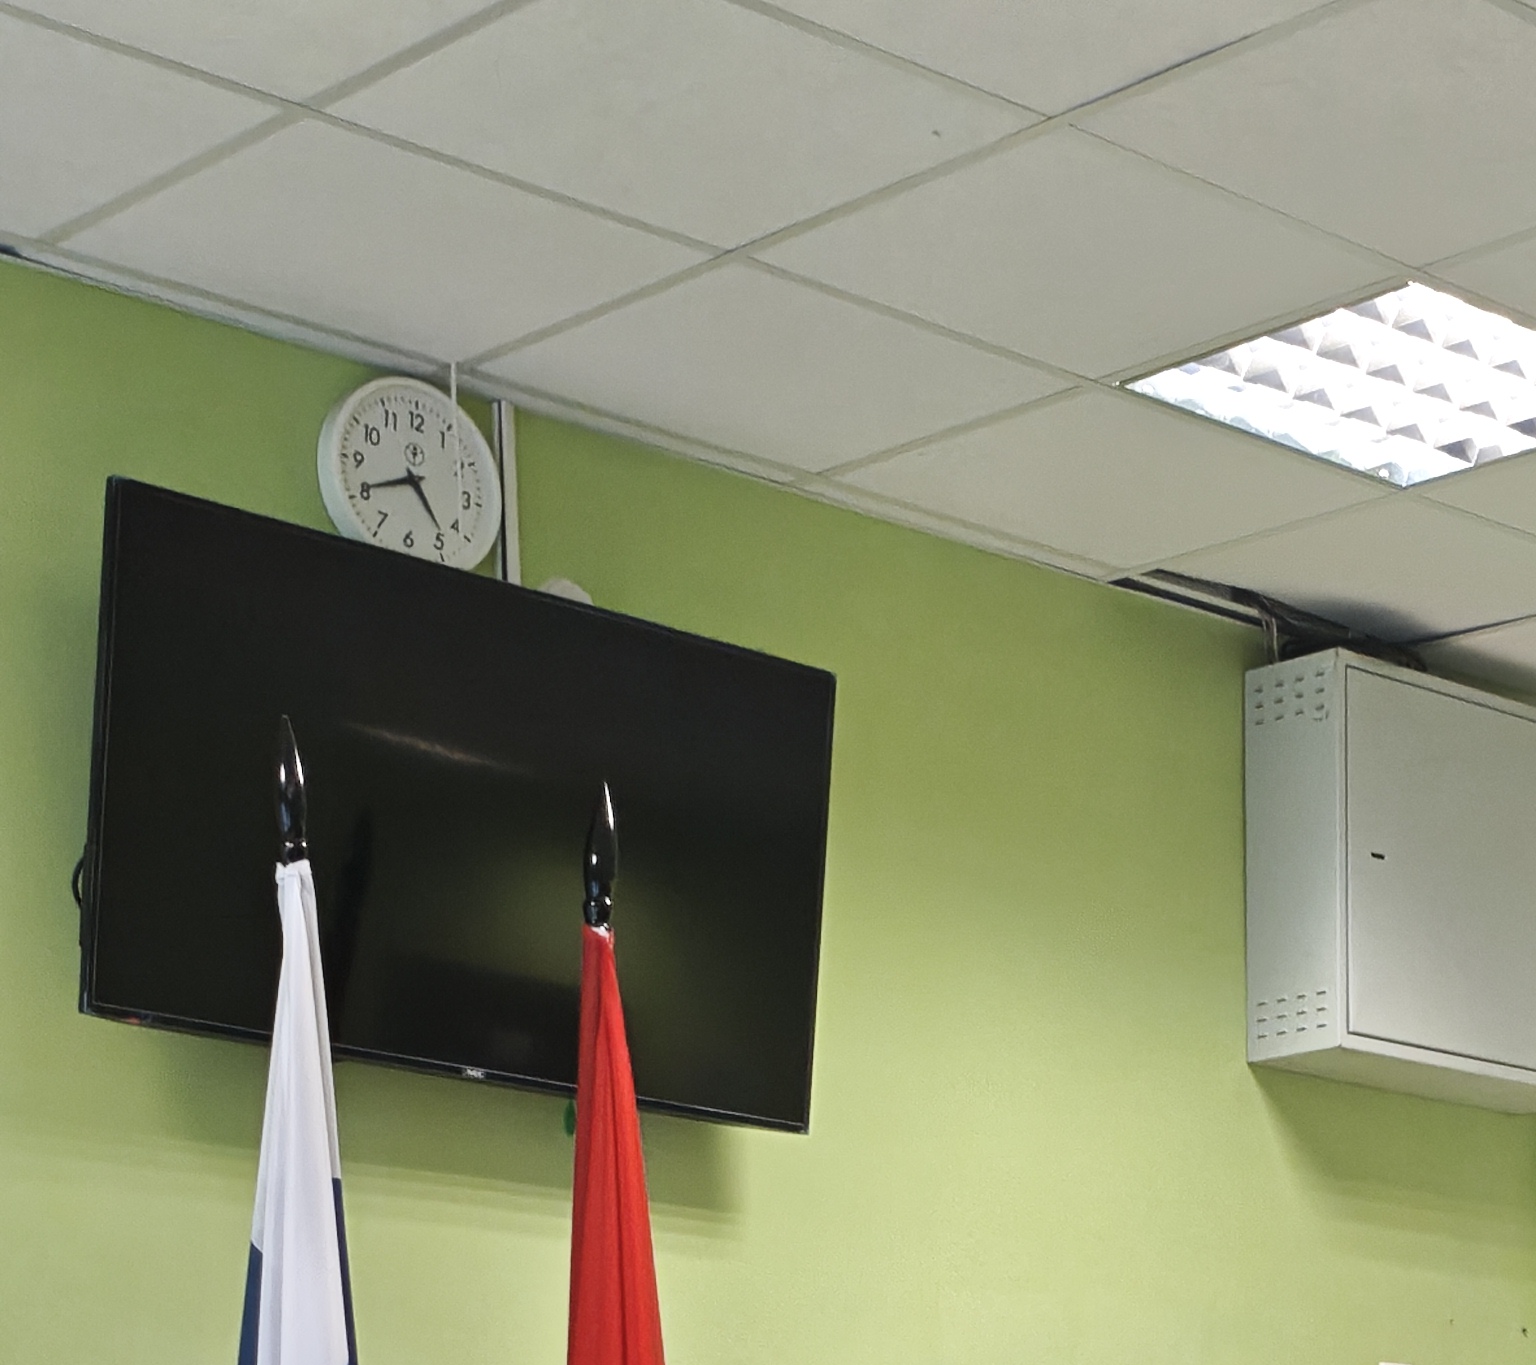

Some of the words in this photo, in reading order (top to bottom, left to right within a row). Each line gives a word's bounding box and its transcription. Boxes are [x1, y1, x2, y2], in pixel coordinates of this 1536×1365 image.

[384, 409, 398, 432] 11
[409, 411, 425, 434] 12
[364, 424, 380, 446] 10
[440, 431, 445, 449] 1
[353, 451, 365, 469] 9
[360, 482, 371, 501] 8
[462, 491, 471, 510] 3
[378, 511, 389, 529] 7
[450, 518, 460, 534] 4
[403, 531, 415, 548] 6
[433, 532, 445, 550] 5
